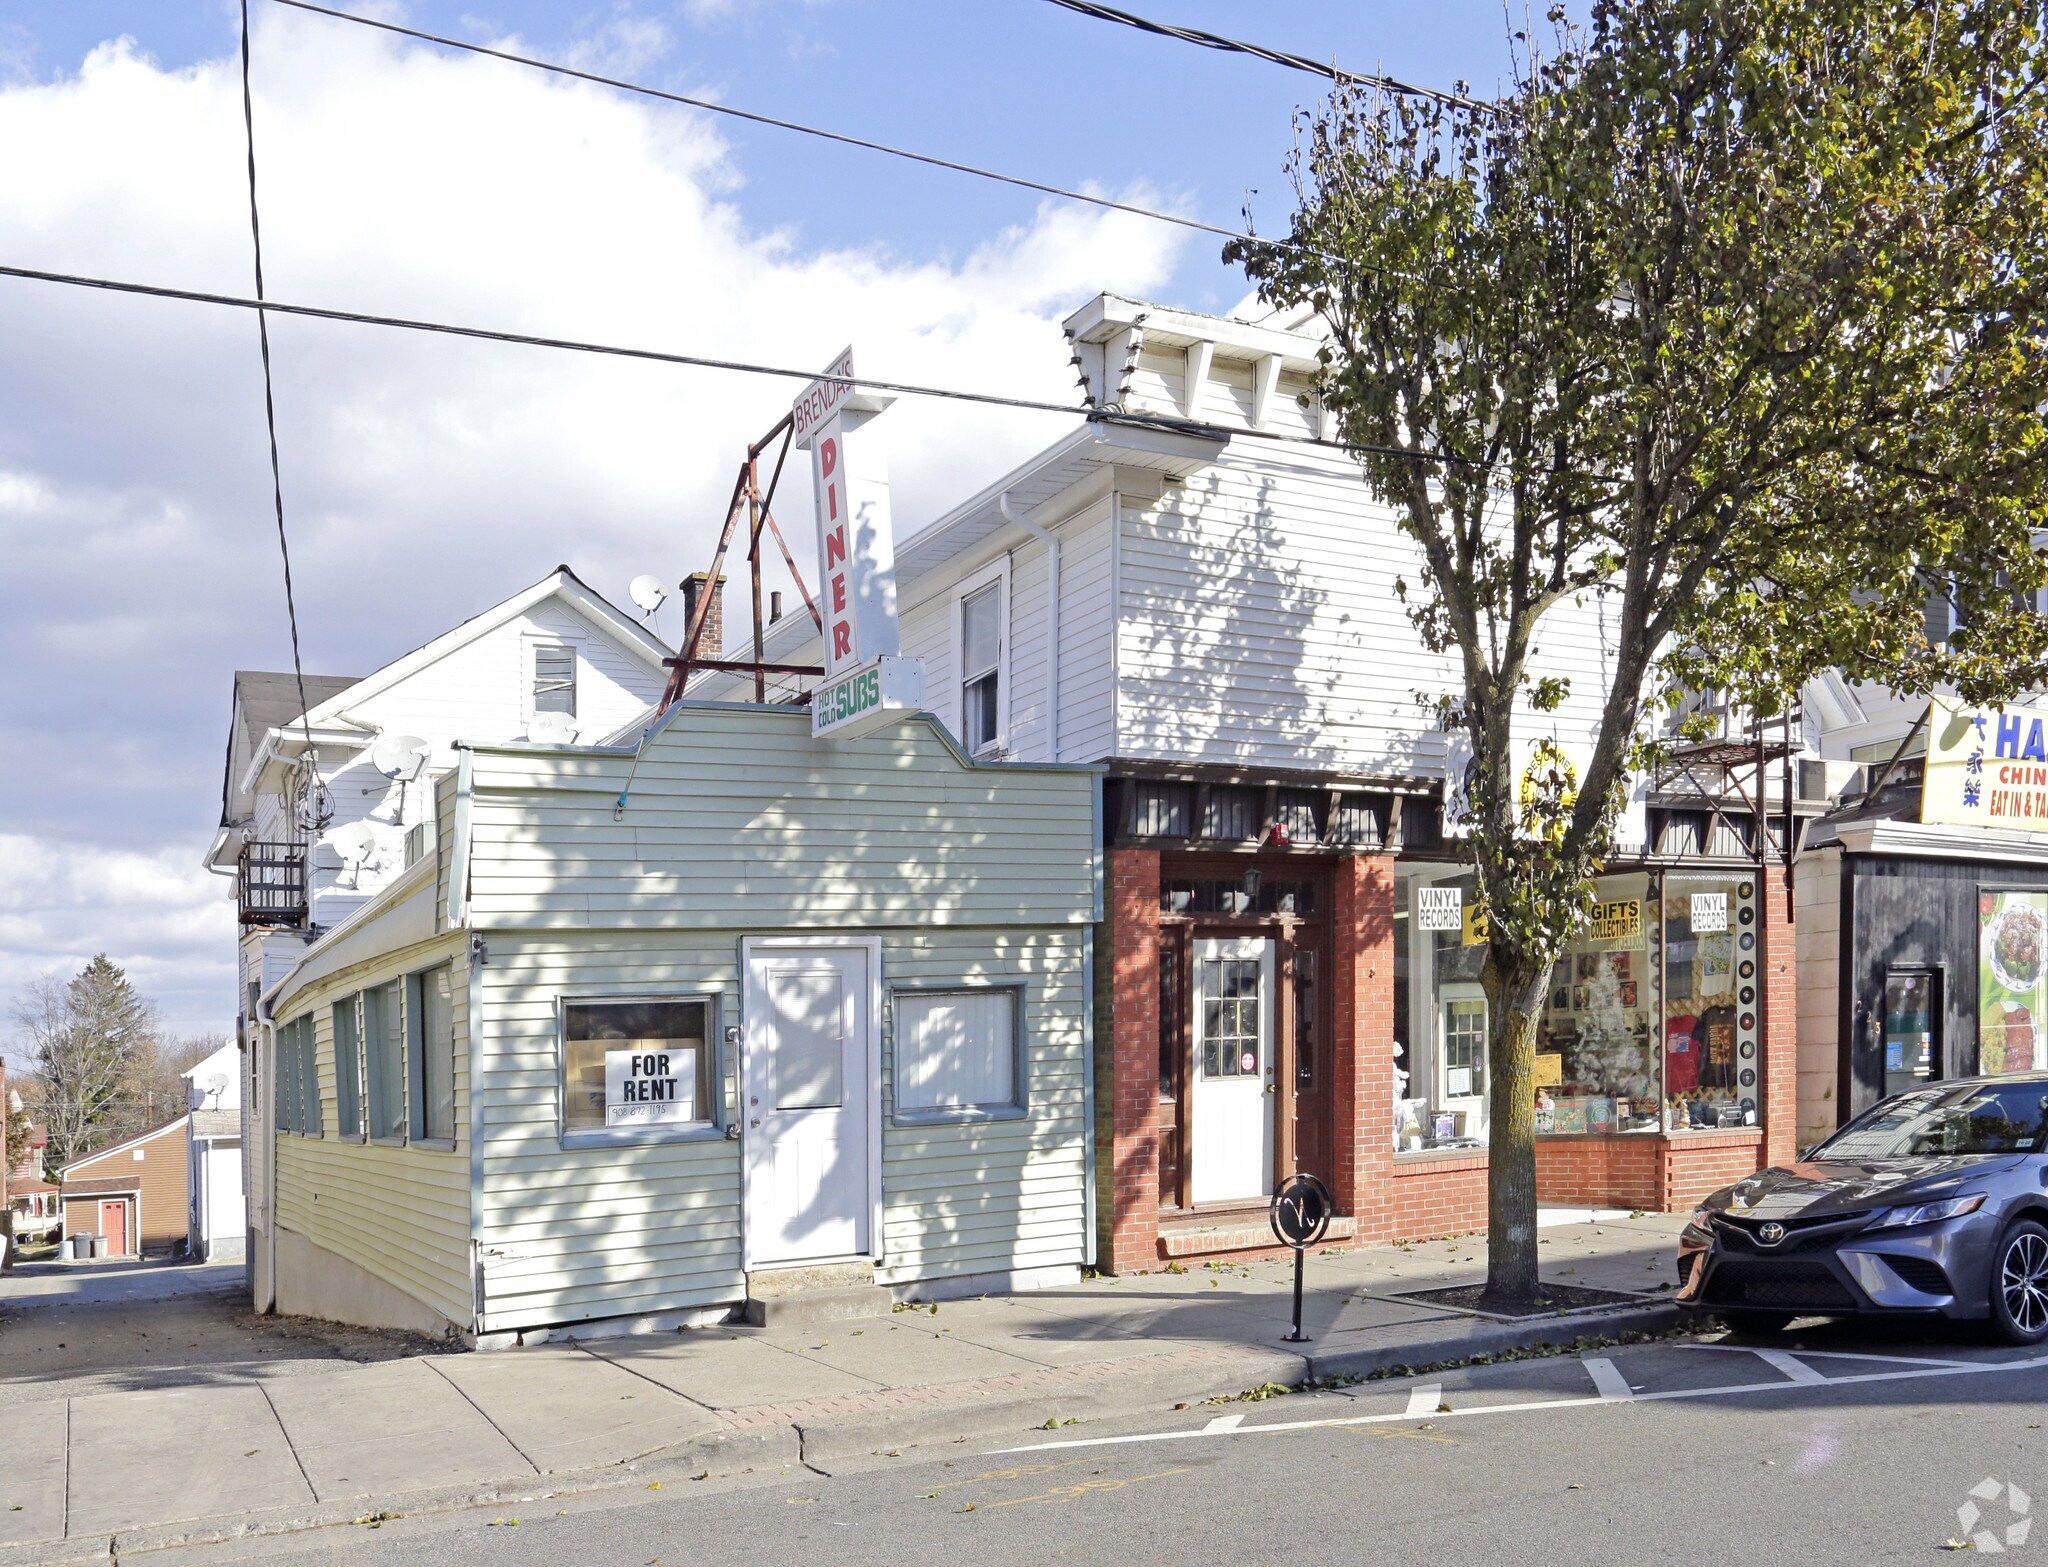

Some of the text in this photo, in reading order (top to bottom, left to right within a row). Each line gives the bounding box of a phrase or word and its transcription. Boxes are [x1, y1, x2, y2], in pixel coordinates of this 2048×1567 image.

[795, 359, 852, 434] BRENDA'S
[820, 437, 852, 661] DINER
[818, 688, 836, 709] HOT
[835, 668, 880, 721] SUBS
[818, 707, 836, 728] COLD
[1989, 789, 2048, 819] EAT IN & TA
[1420, 889, 1460, 907] VINYL
[1692, 895, 1726, 911] VINYL
[1420, 908, 1460, 928] RECORDS
[1590, 901, 1639, 921] GIFTS
[1692, 911, 1726, 930] RECORDS
[1590, 918, 1639, 940] COLLECTIBLES
[631, 1054, 670, 1077] FOR
[623, 1078, 678, 1102] RENT
